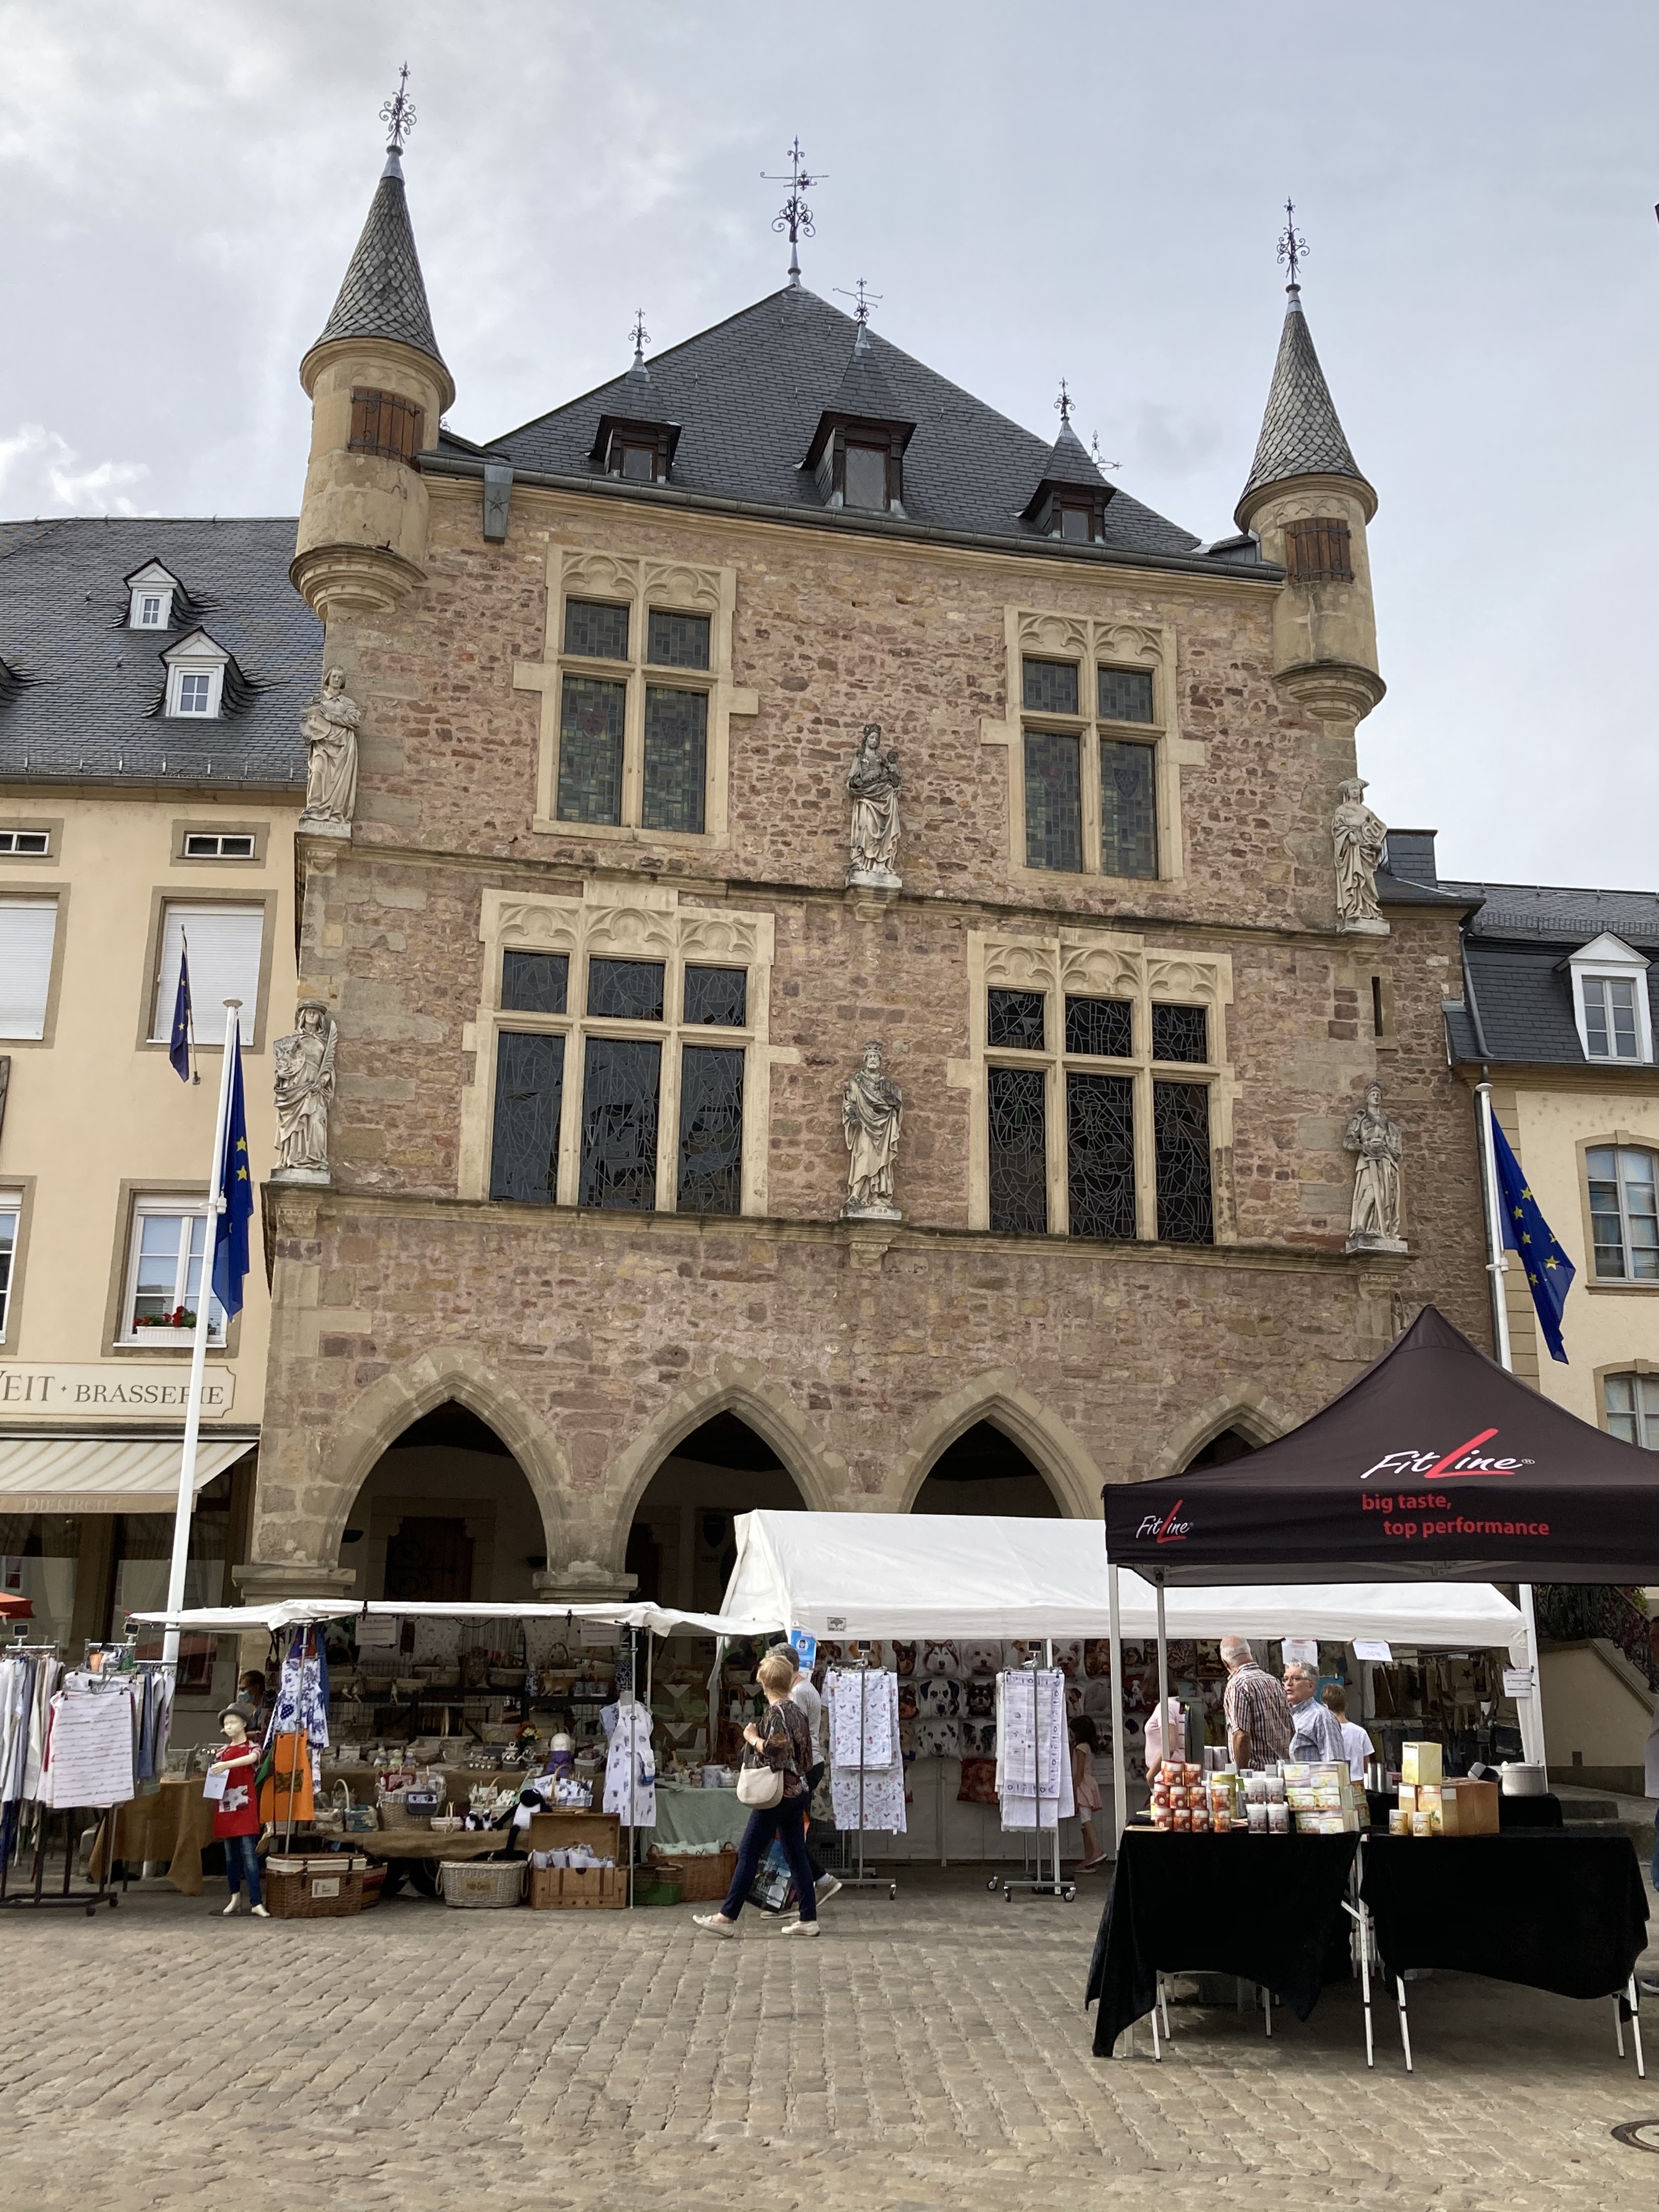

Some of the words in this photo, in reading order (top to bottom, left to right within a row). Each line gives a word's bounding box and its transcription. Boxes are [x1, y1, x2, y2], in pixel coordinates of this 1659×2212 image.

[0, 1370, 55, 1401] EIT
[1362, 1493, 1393, 1514] big
[1398, 1494, 1453, 1510] taste,
[1383, 1520, 1418, 1539] top
[1423, 1516, 1550, 1538] performance
